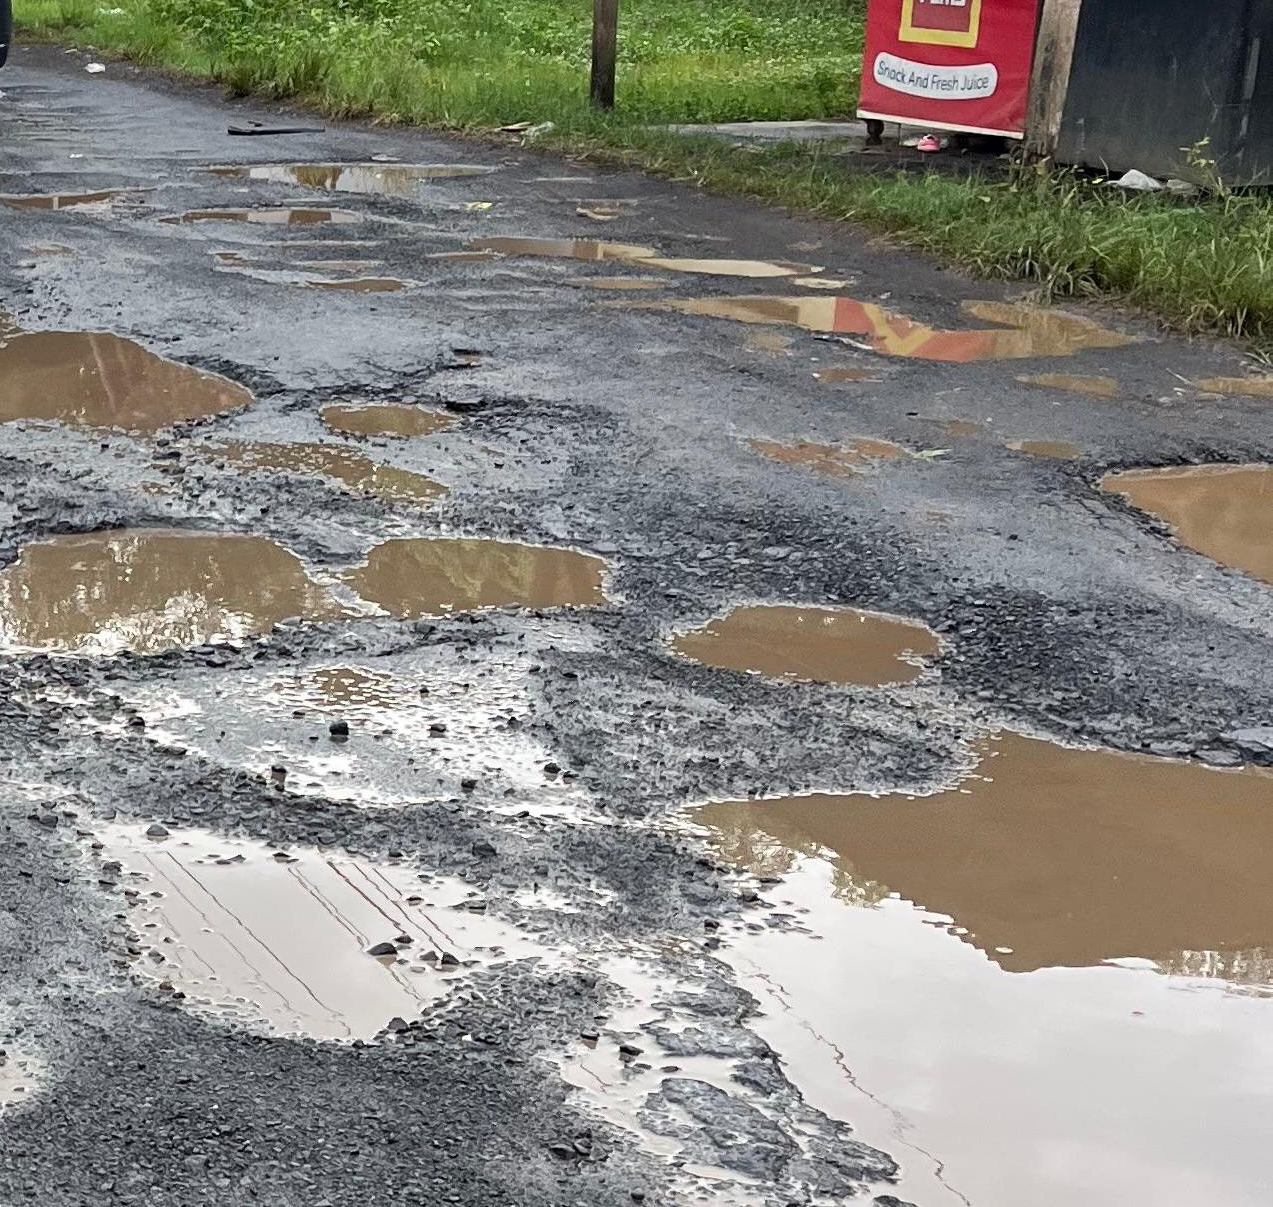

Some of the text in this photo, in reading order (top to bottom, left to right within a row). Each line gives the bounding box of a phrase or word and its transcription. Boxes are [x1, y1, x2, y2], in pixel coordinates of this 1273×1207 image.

[877, 60, 990, 92] Snack And Fresh Juice
